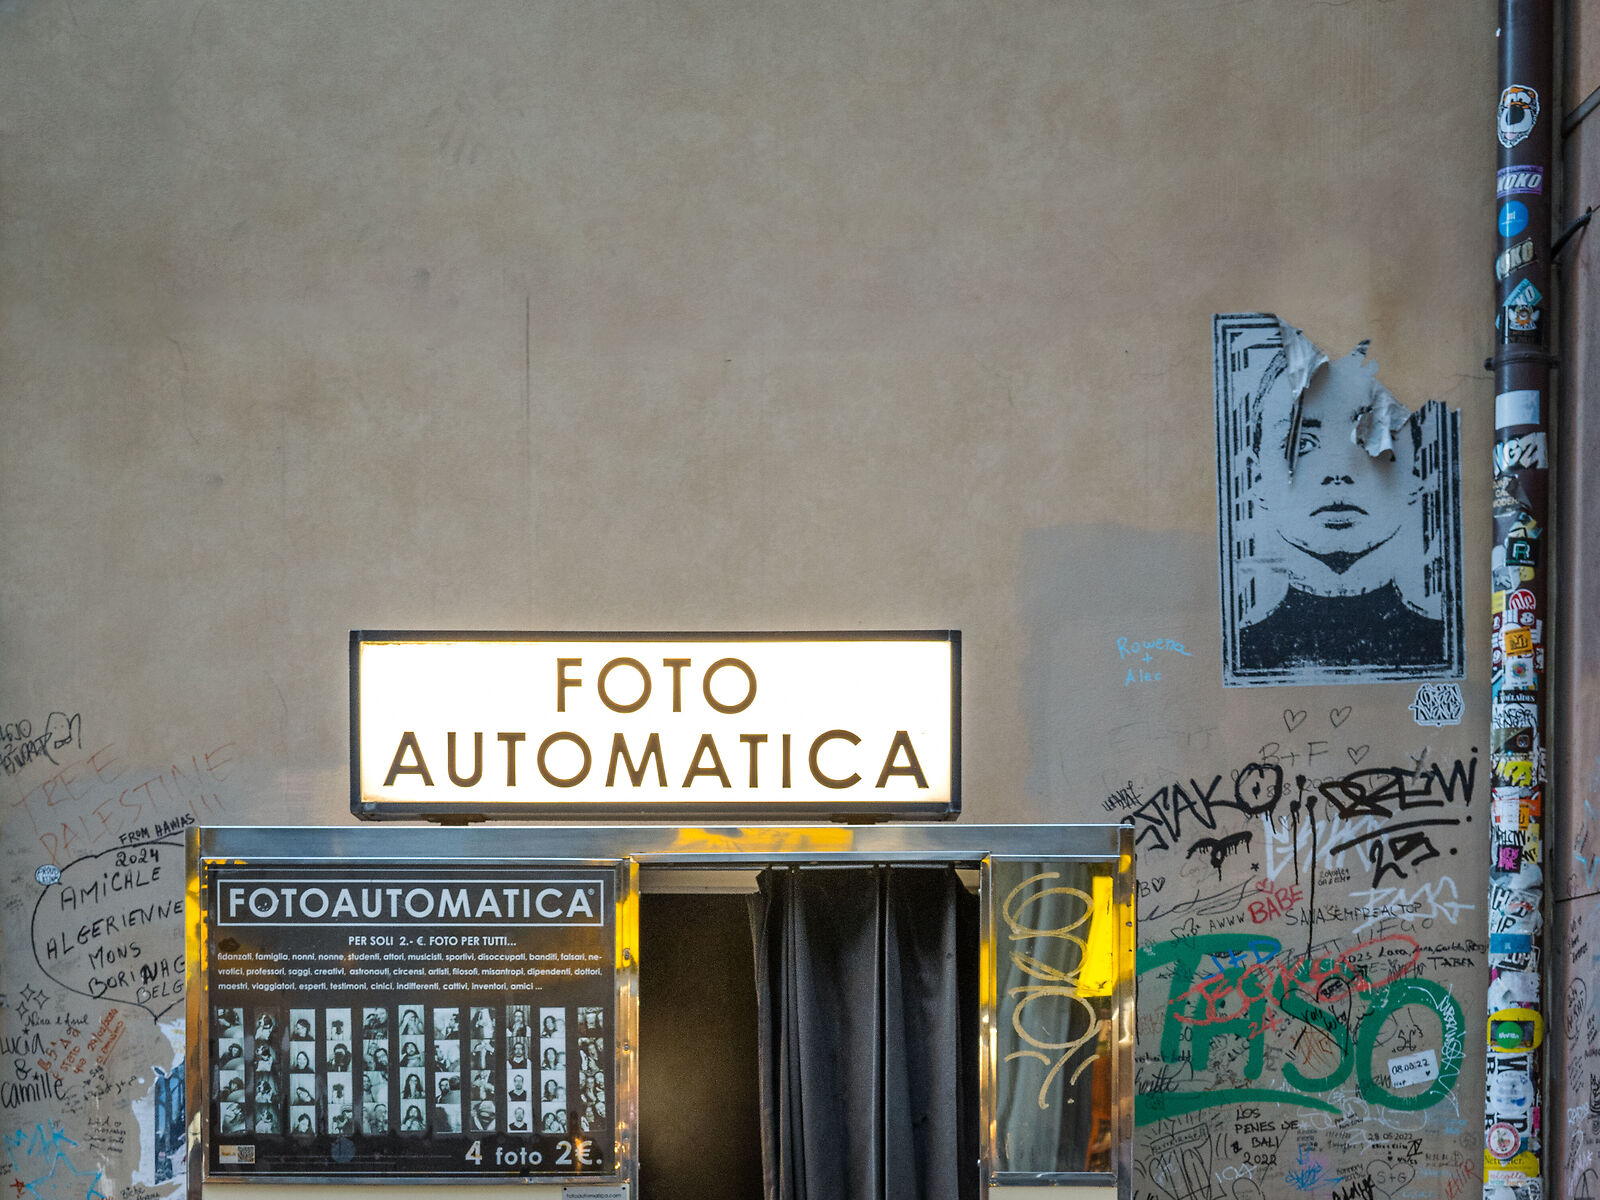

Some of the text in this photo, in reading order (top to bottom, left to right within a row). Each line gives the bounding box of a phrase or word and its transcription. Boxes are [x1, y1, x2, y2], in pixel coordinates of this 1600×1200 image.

[557, 656, 758, 715] FOTO
[1124, 668, 1163, 687] Alec
[383, 728, 930, 790] AUTOMATICA
[115, 847, 159, 868] 2024
[1247, 884, 1304, 924] BABE
[348, 936, 367, 946] PER
[369, 936, 394, 946] SOLI
[429, 936, 458, 947] FOTO
[461, 936, 480, 947] PER
[88, 940, 142, 971] MONS
[217, 952, 253, 962] fidanzati,
[255, 952, 290, 963] famiglia,
[292, 952, 317, 962] nonni,
[318, 953, 346, 962] nonne,
[347, 953, 380, 962] studenti,
[383, 953, 406, 962] attori,
[407, 953, 444, 962] musicisti,
[445, 953, 477, 963] sportivi,
[477, 953, 528, 963] disoccupati,
[529, 953, 560, 962] banditi,
[560, 953, 587, 962] falsari,
[217, 967, 602, 977] vrotici, professori, saggi, creativi, astronauti, circensi, artisti, filosofi, misantropi, dipendenti, dottori,
[217, 982, 250, 991] maestri,
[251, 982, 297, 992] viaggiatori,
[298, 982, 329, 992] esperti,
[329, 982, 369, 992] testimoni,
[370, 982, 395, 992] cinici,
[396, 982, 440, 992] indifferenti,
[442, 982, 470, 992] cattivi,
[471, 982, 509, 992] inventori,
[510, 982, 534, 991] amici
[1236, 1108, 1261, 1121] LOS
[1235, 1121, 1277, 1134] PENES
[1251, 1135, 1280, 1149] BALI
[465, 1140, 483, 1165] 4
[495, 1146, 543, 1166] foto
